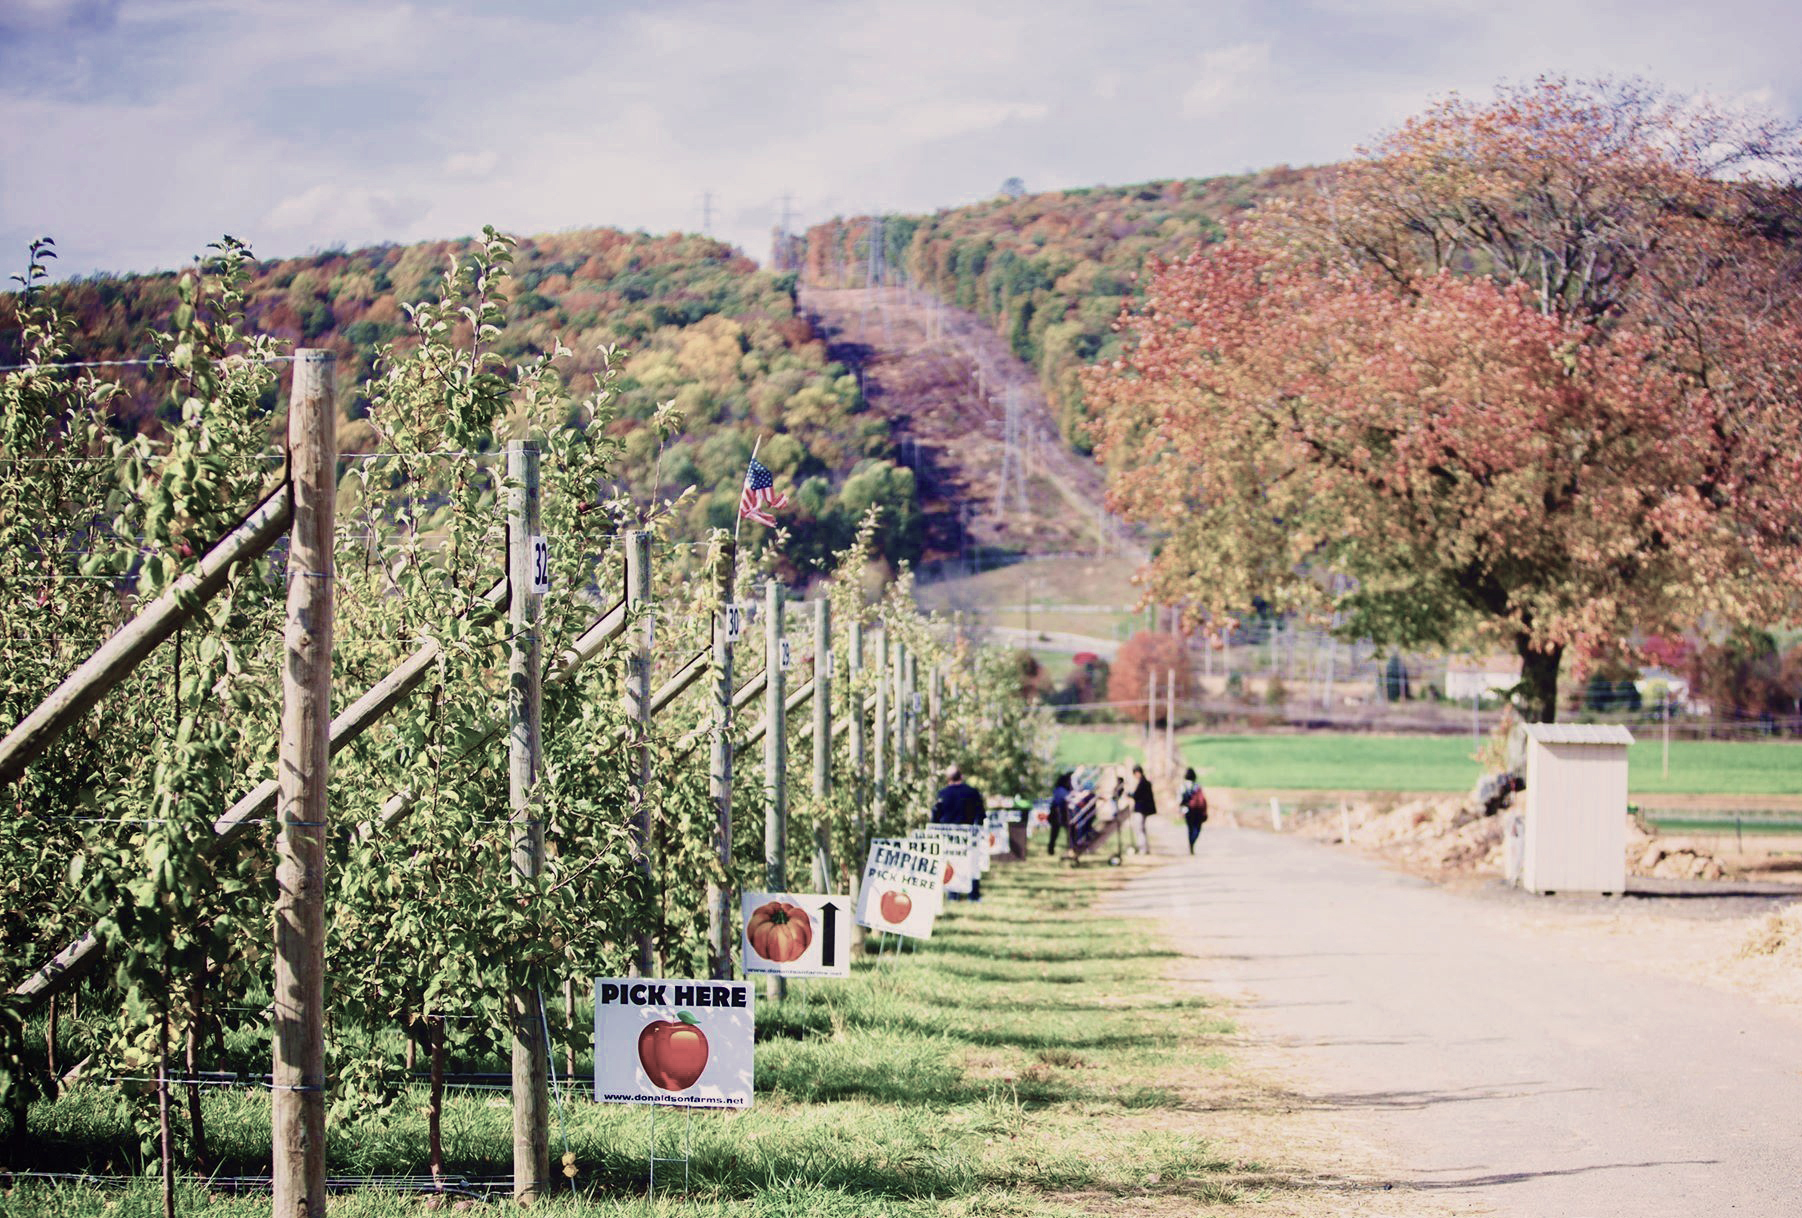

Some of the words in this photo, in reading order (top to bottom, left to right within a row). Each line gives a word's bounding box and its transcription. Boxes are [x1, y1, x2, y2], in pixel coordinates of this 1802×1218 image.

[535, 543, 547, 585] 32
[729, 608, 738, 635] 30
[875, 848, 938, 875] EMPIRE
[868, 868, 896, 881] PICK
[902, 875, 935, 889] HERE
[602, 984, 666, 1005] PICK
[675, 986, 746, 1007] HERE
[604, 1094, 744, 1104] www.donaldsonfarms.net
